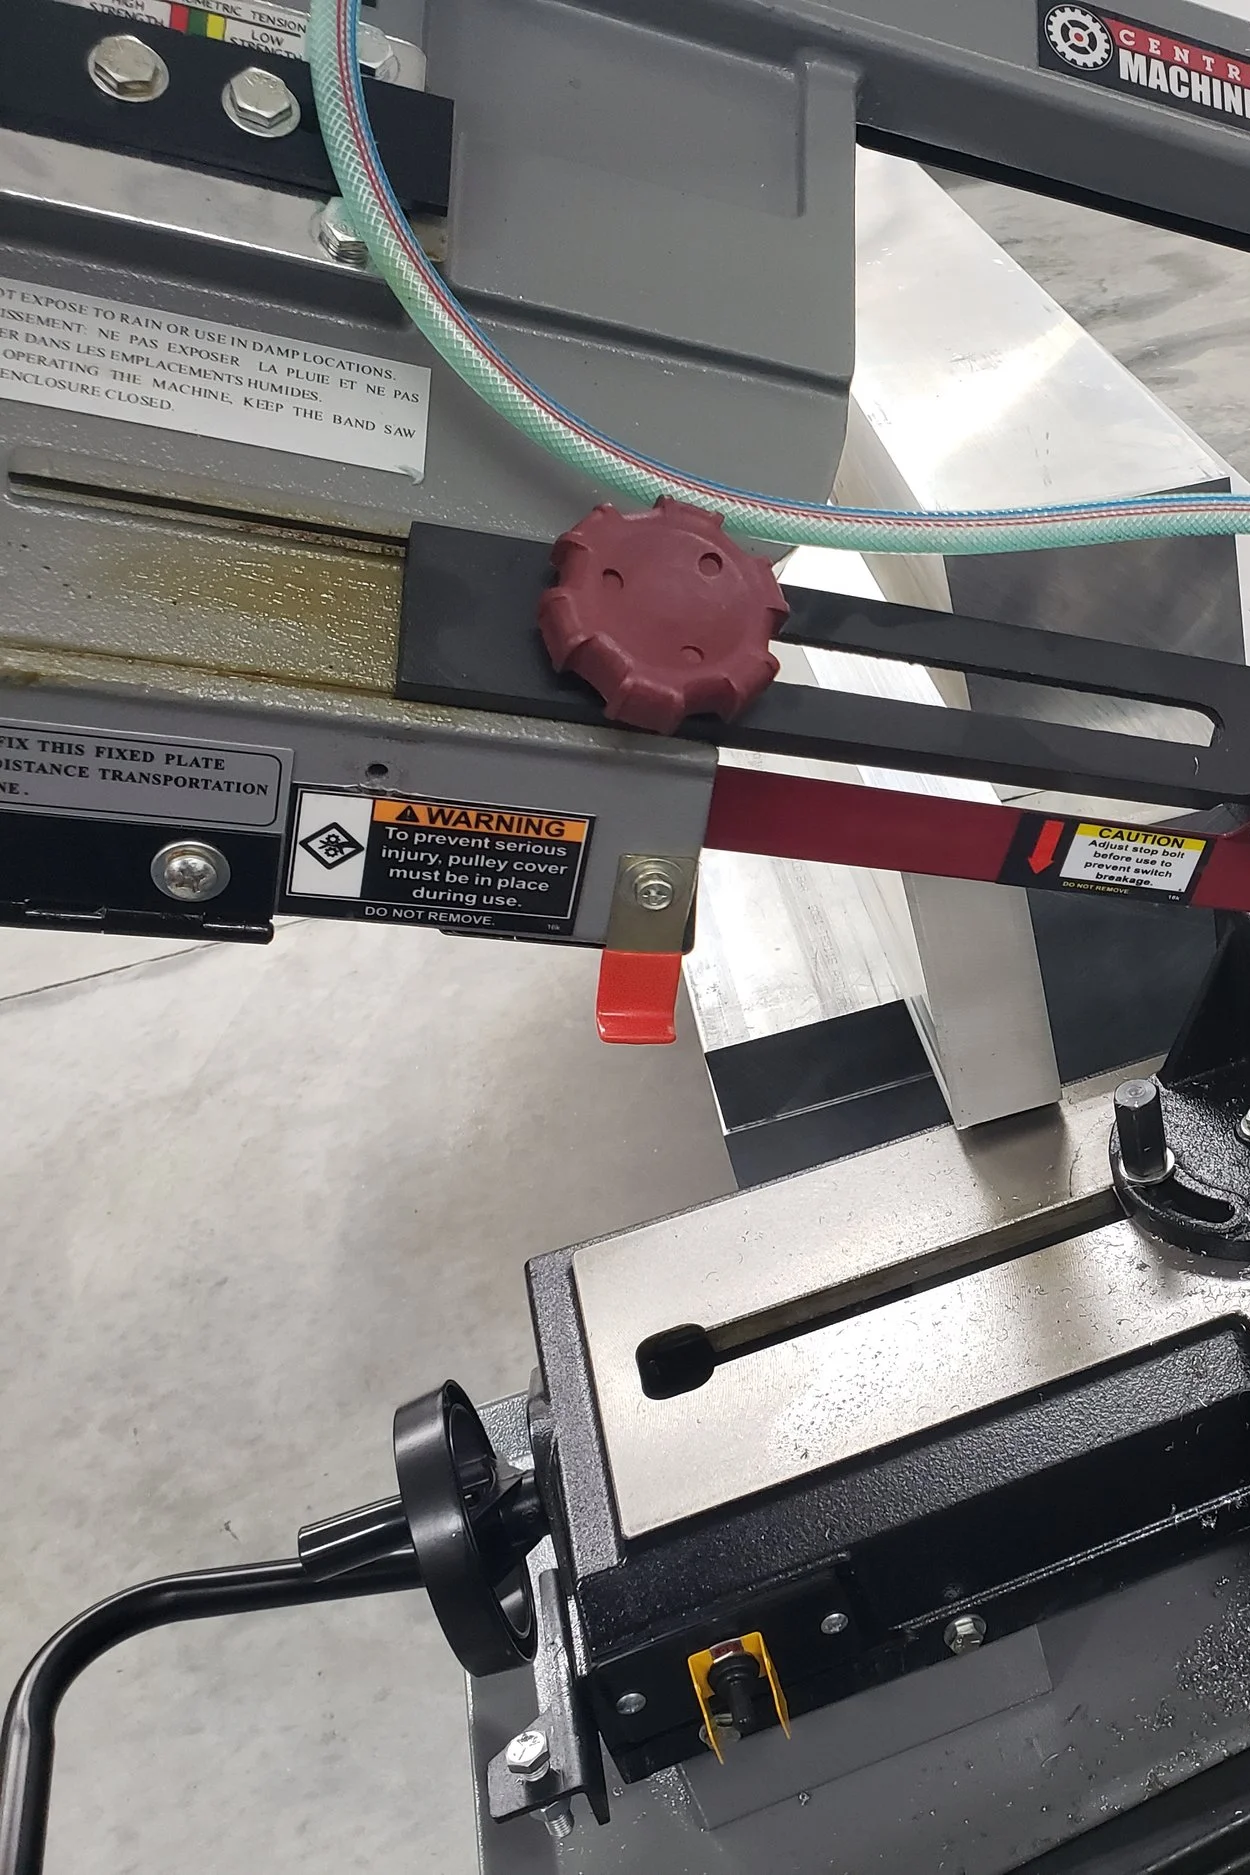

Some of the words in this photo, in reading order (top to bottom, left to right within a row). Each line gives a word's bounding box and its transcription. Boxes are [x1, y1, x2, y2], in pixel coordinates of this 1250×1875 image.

[250, 10, 307, 34] TENSION
[251, 29, 284, 46] LOW
[21, 292, 89, 315] EXPOSE
[92, 307, 116, 321] TO
[120, 313, 162, 331] RAIN
[166, 323, 190, 338] OR
[194, 329, 227, 345] USE
[231, 336, 248, 349] IN
[252, 341, 300, 360] DAMP
[303, 352, 396, 381] LOCATIONS.
[25, 332, 71, 351] DANS
[76, 343, 106, 358] LES
[110, 350, 244, 386] EMPLACEMENTS
[248, 378, 322, 403] HUMIDES.
[98, 327, 120, 342] NE
[129, 334, 158, 350] PAS
[167, 342, 240, 367] EXPOSER
[259, 361, 278, 375] LA
[287, 367, 330, 385] PLUIE
[339, 378, 358, 390] ET
[366, 384, 386, 397] NE
[393, 389, 420, 403] PAS
[0, 368, 101, 397] ENCLOSURE
[105, 388, 175, 412] CLOSED.
[3, 348, 99, 377] OPERATING
[110, 369, 142, 385] THE
[243, 397, 284, 413] KEEP
[292, 405, 323, 422] THE
[333, 414, 376, 431] BAND
[384, 424, 416, 439] SAW
[37, 739, 85, 756] THIS
[95, 746, 155, 763] FIXED
[164, 753, 225, 771] PLATE
[0, 758, 90, 779] ISTANCE
[98, 767, 268, 796] TRANSPORTATION
[427, 807, 565, 837] WARNING
[385, 827, 409, 840] To
[414, 832, 490, 850] prevent
[495, 839, 567, 857] serious
[1088, 839, 1129, 852] Adjust
[1132, 845, 1158, 856] stop
[1162, 849, 1185, 859] bolt
[1098, 828, 1185, 849] CAUTION
[381, 846, 443, 866] injury,
[448, 852, 508, 872] pulley
[513, 860, 568, 875] cover
[1084, 861, 1131, 875] prevent
[1133, 865, 1172, 878] switch
[1093, 851, 1132, 862] before
[1135, 857, 1157, 866] use
[1160, 859, 1172, 868] to
[389, 867, 440, 883] must
[446, 870, 469, 885] be
[475, 873, 492, 887] in
[497, 875, 549, 892] place
[1076, 882, 1094, 890] NOT
[1095, 885, 1129, 894] REMOVE
[1095, 871, 1153, 887] breakage.
[412, 886, 477, 906] during
[482, 893, 522, 908] use.
[365, 906, 388, 917] DO
[392, 908, 425, 920] NOT
[428, 911, 495, 926] REMOVE.
